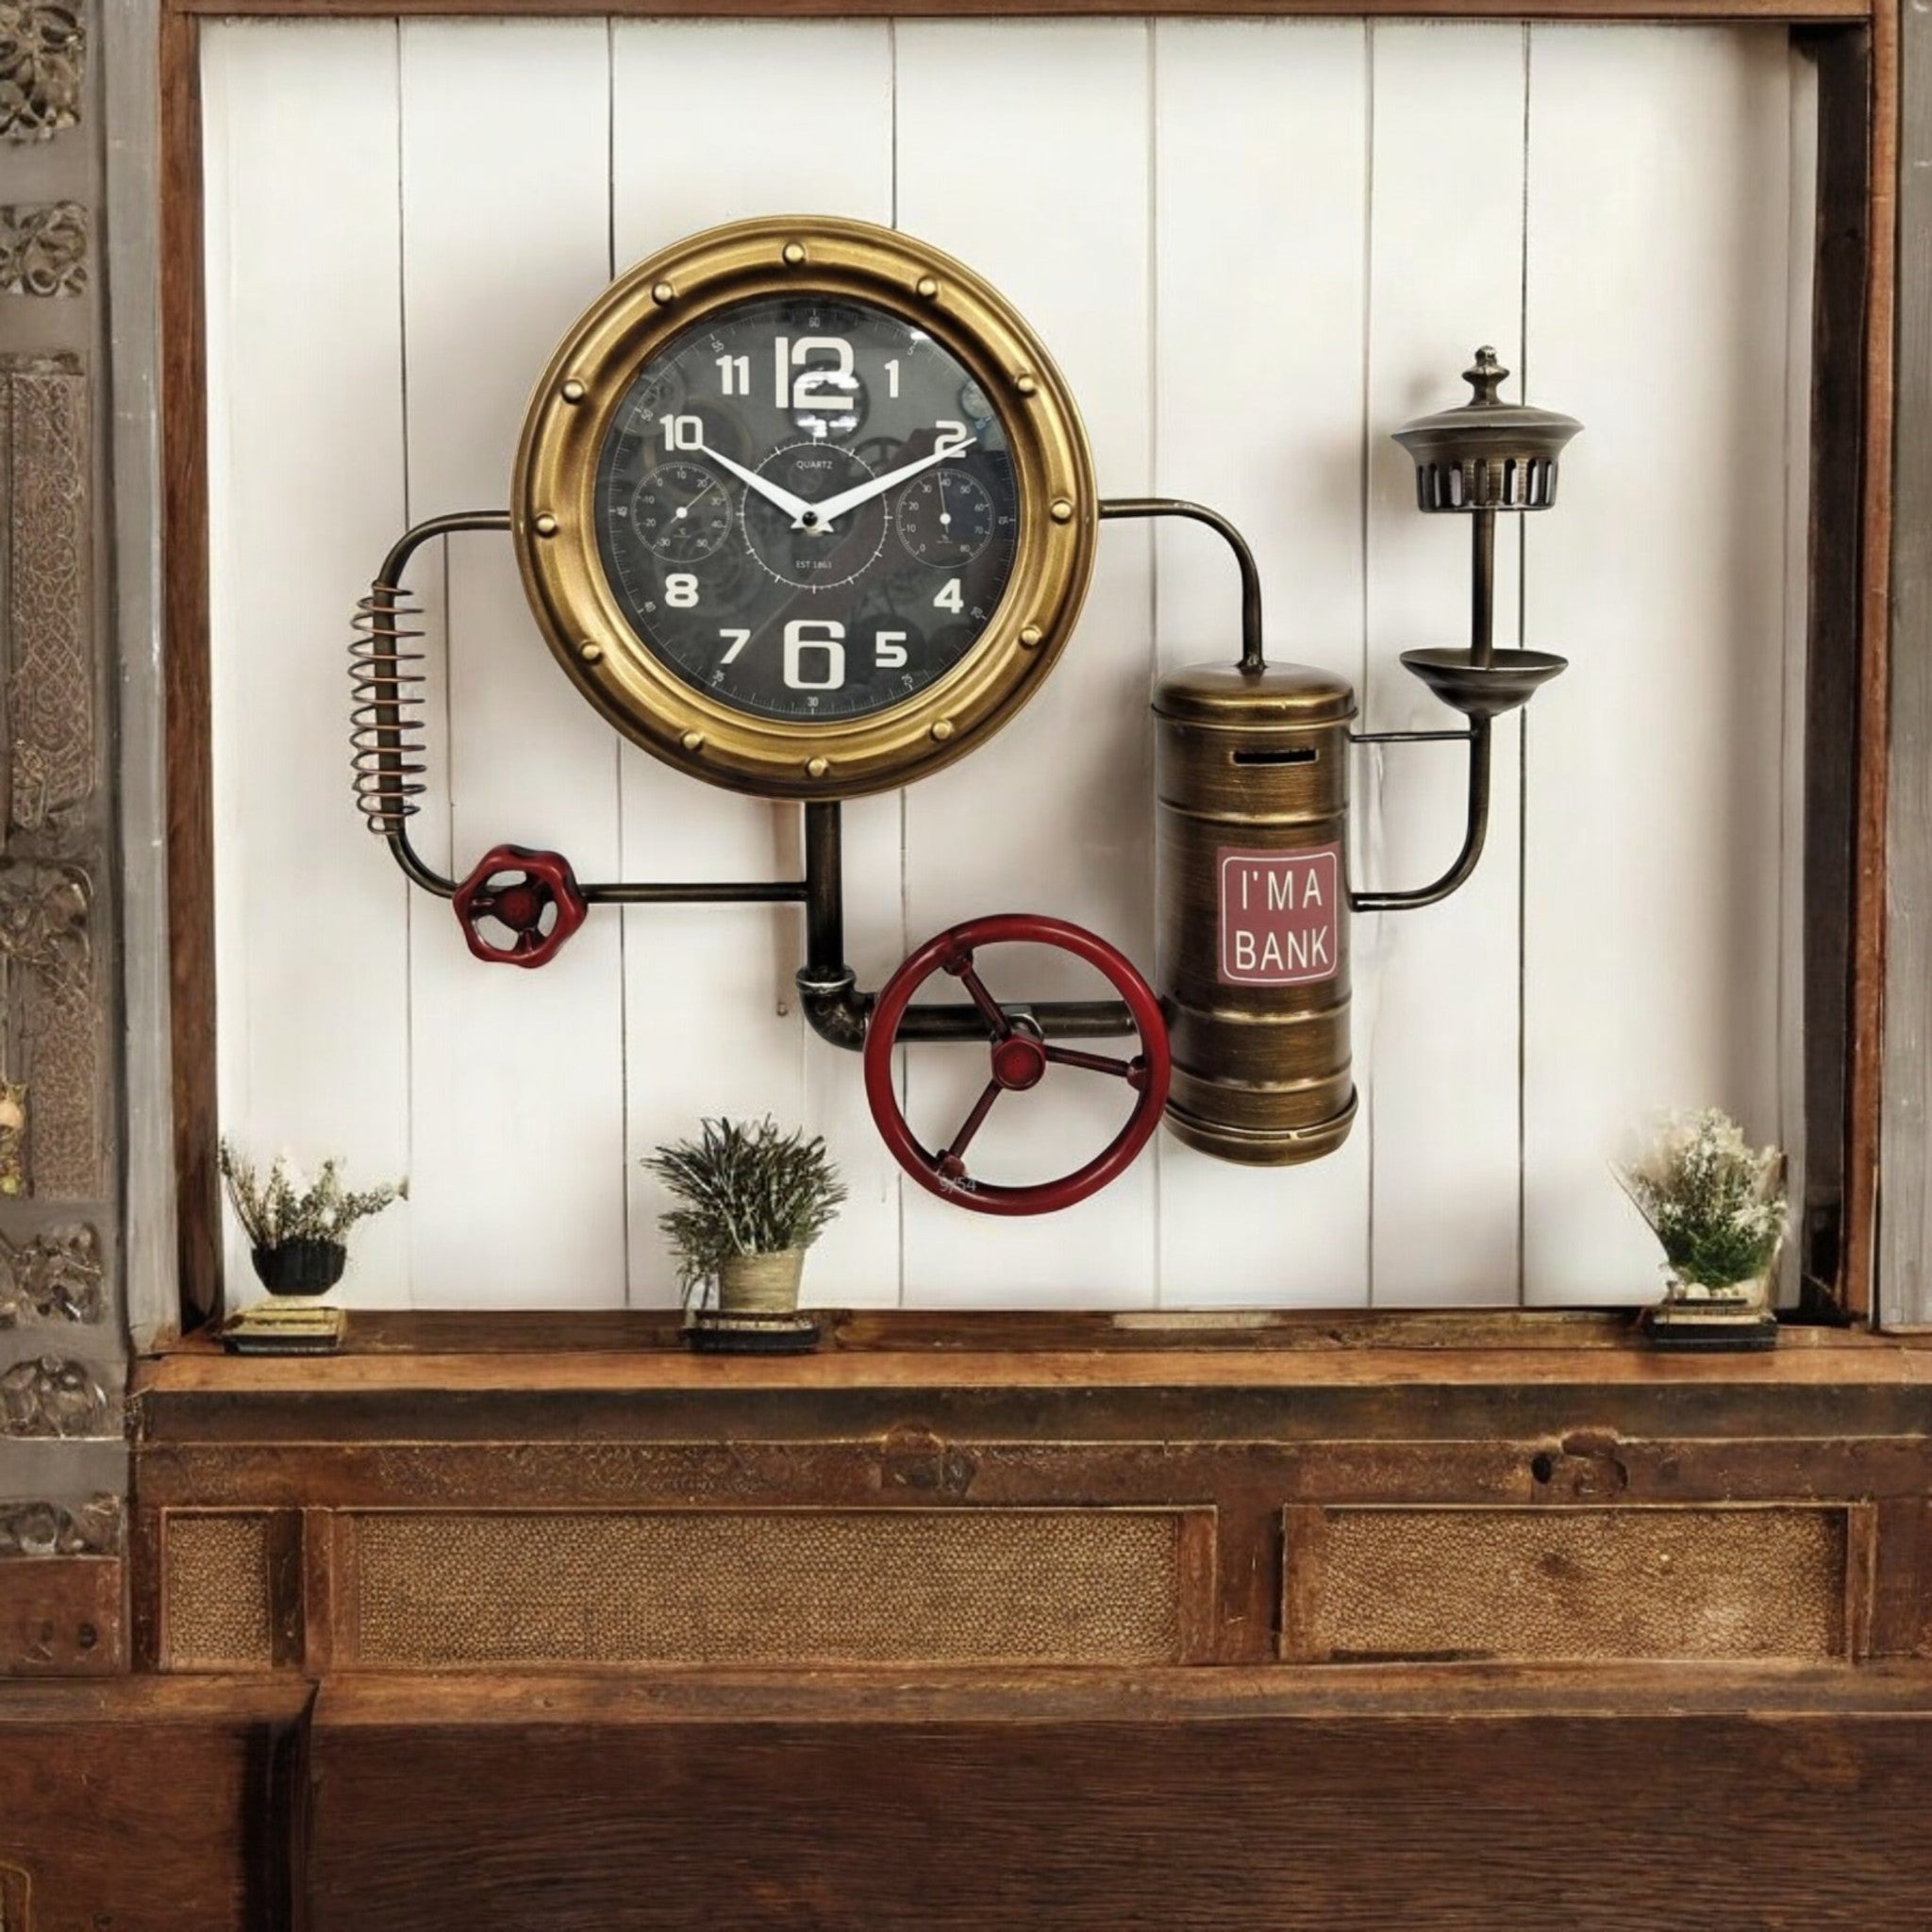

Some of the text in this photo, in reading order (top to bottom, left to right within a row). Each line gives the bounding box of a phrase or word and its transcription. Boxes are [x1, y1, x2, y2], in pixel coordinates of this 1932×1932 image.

[715, 355, 750, 395] 11
[774, 336, 855, 409] 12
[884, 359, 899, 398] 1
[658, 413, 704, 451] 10
[934, 420, 967, 458] 2
[796, 459, 833, 470] QUARTZ
[908, 501, 920, 511] 20
[907, 524, 917, 533] 10
[795, 559, 810, 569] EST
[664, 573, 700, 608] 8
[933, 578, 964, 614] 4
[719, 628, 752, 664] 7
[783, 619, 846, 691] 6
[875, 630, 908, 668] 5
[1241, 868, 1323, 911] I'M A
[1235, 924, 1329, 972] BANK
